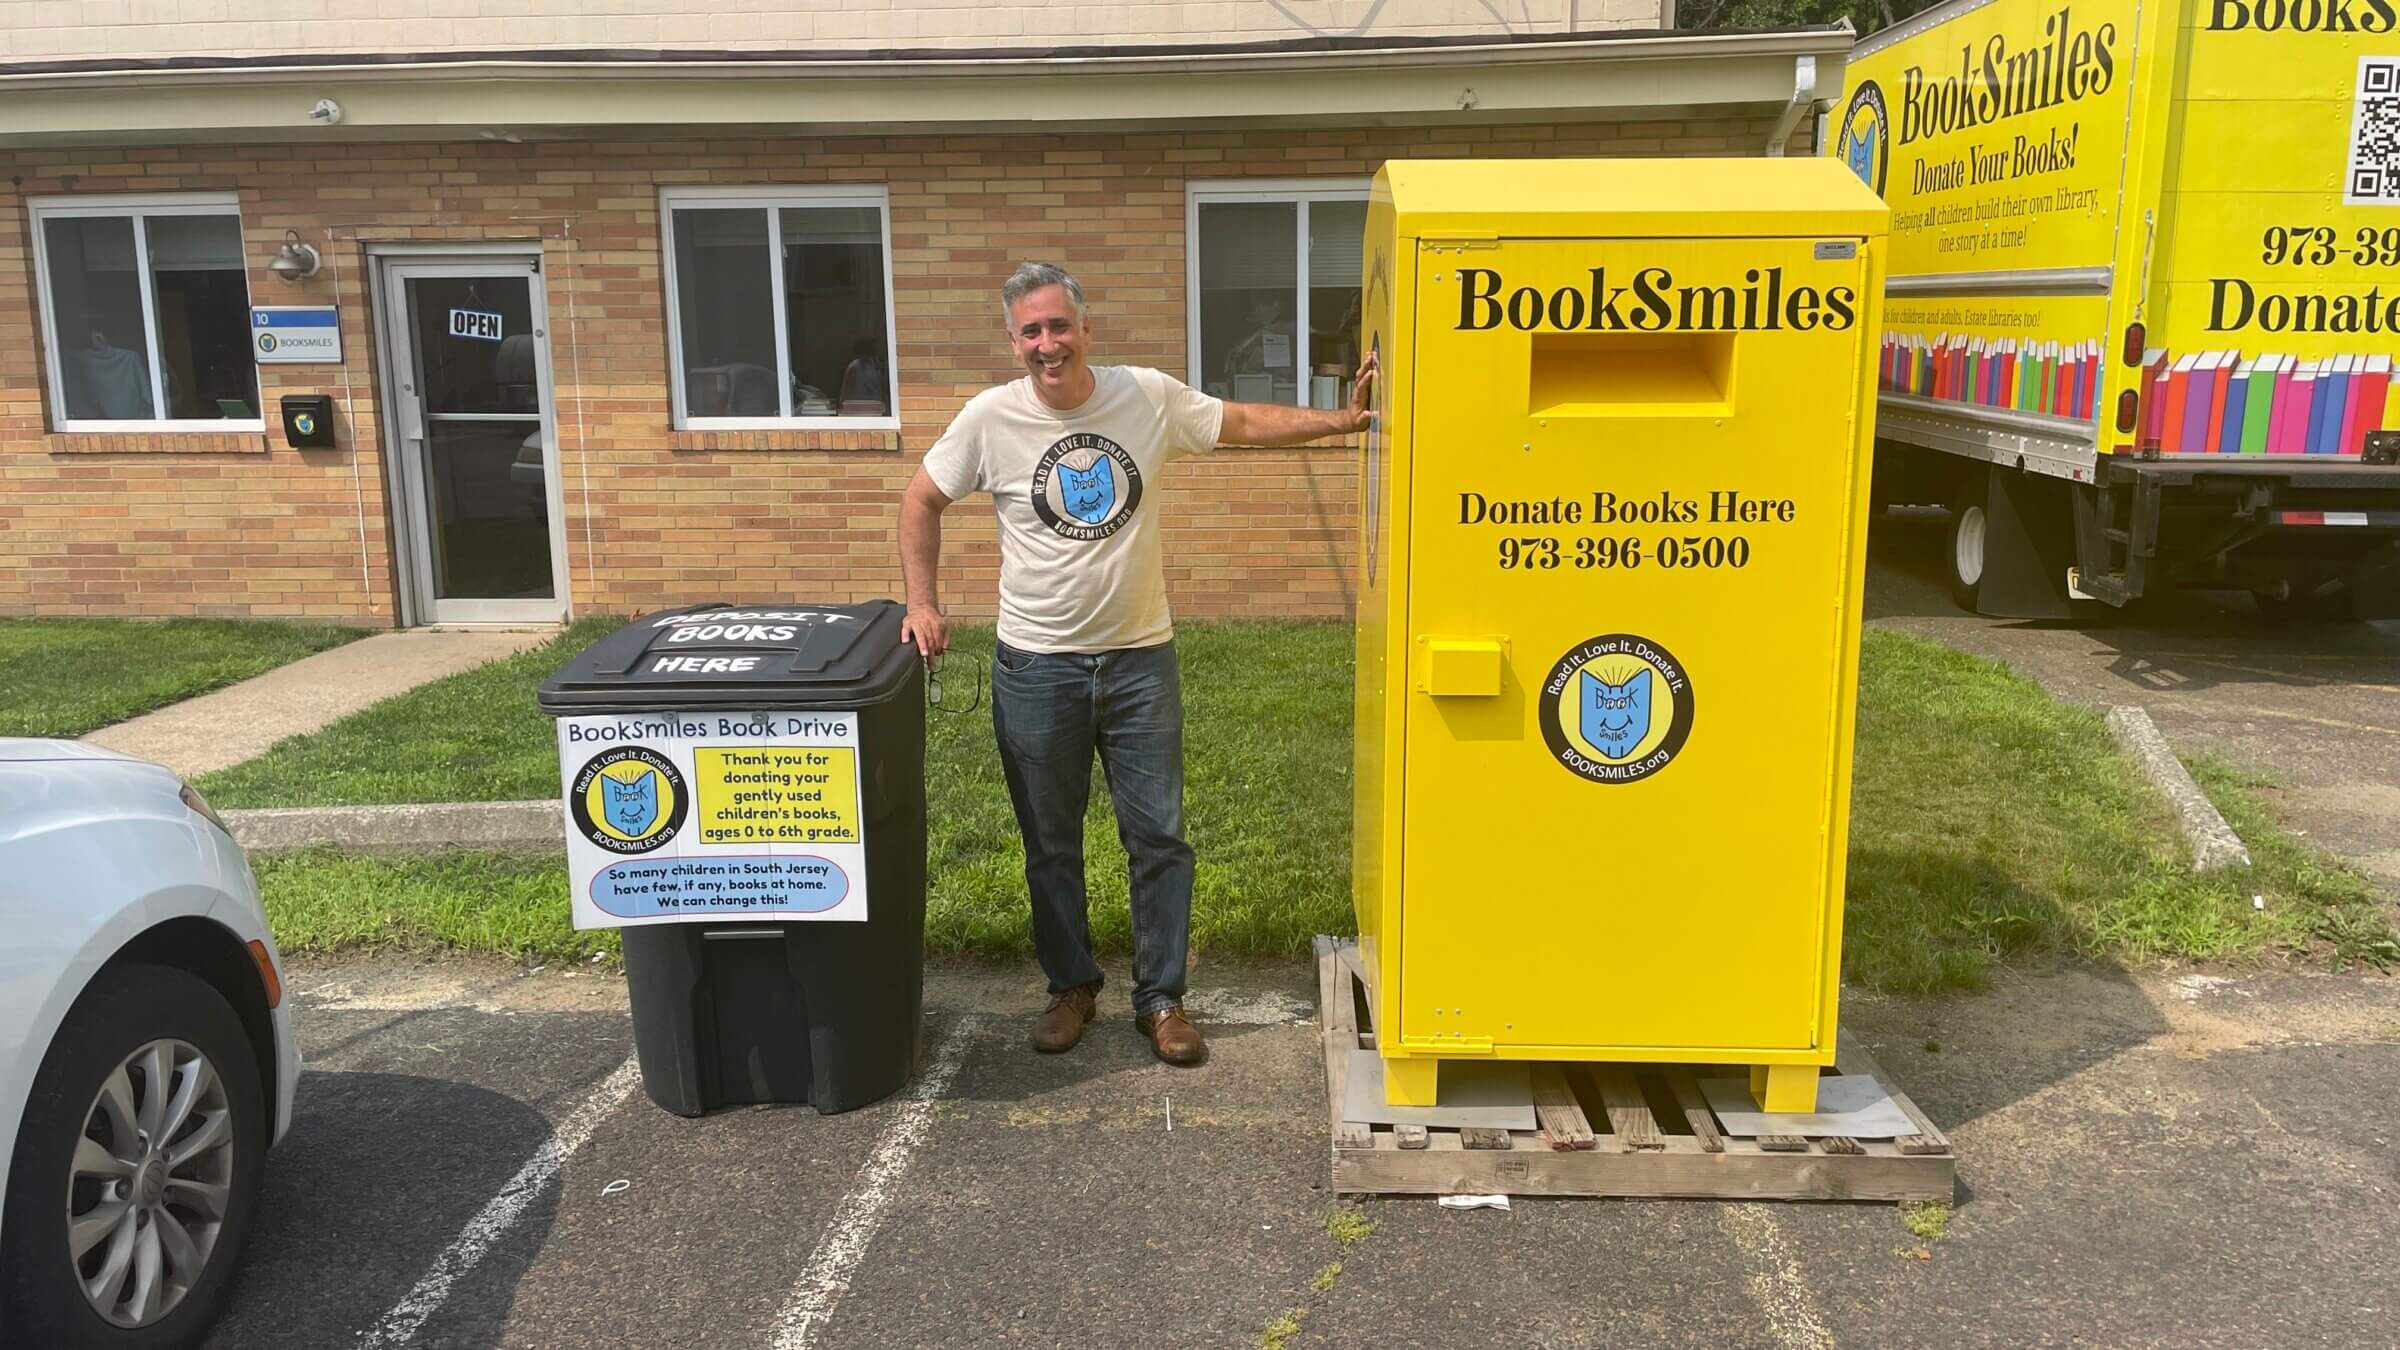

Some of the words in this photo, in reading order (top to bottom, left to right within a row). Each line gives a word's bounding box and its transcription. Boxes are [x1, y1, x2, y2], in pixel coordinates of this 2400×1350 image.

[1898, 6, 2116, 146] BookSmiles
[1912, 155, 1964, 196] Donate
[1970, 144, 2009, 186] Your
[2011, 122, 2079, 179] Books!
[1894, 211, 1923, 233] Helping
[1924, 207, 1935, 227] all
[1937, 204, 1973, 225] children
[1975, 197, 2000, 221] build
[2002, 194, 2027, 218] their
[2029, 195, 2053, 215] own
[2055, 187, 2099, 214] library,
[1938, 237, 1955, 253] one
[1956, 233, 1979, 256] story
[1980, 232, 1990, 249] at
[1992, 234, 1998, 249] a
[2000, 226, 2027, 248] time!
[2262, 226, 2400, 267] 973-39
[1454, 267, 1855, 331] BookSmiles
[255, 313, 269, 326] 10
[454, 311, 498, 338] OPEN
[1900, 308, 1926, 325] children
[1927, 308, 1939, 325] and
[1964, 309, 1987, 326] Estate
[1989, 308, 2022, 328] libraries
[2024, 310, 2041, 328] too!
[281, 339, 333, 348] BOOKSMILES
[1034, 468, 1049, 495] READ
[1054, 437, 1080, 456] LOVE
[1082, 435, 1094, 447] IT.
[1097, 439, 1131, 472] DONATE
[1458, 492, 1582, 525] Donate
[1592, 491, 1698, 524] Books
[1706, 490, 1795, 523] Here
[1054, 507, 1132, 539] BOOKSMILES.ORG
[1499, 536, 1750, 570] 973-396-0500
[652, 612, 855, 628] DEPOSIT
[668, 624, 799, 643] BOOKS
[652, 656, 761, 673] HERE
[1547, 662, 1572, 695] Read
[1570, 653, 1585, 664] It.
[1584, 642, 1617, 659] Love
[1620, 639, 1633, 653] It.
[1635, 643, 1676, 679] Donate
[1671, 679, 1684, 694] It.
[569, 719, 708, 743] BookSmiles
[718, 718, 777, 738] Book
[788, 718, 848, 737] Drive
[576, 771, 594, 793] Read
[591, 762, 603, 772] It.
[601, 752, 626, 765] Love
[628, 749, 639, 760] It.
[640, 751, 673, 777] Donate
[721, 753, 770, 766] Thank
[775, 756, 802, 768] you
[806, 753, 829, 766] for
[1562, 749, 1670, 779] BOOKSMILES.org
[724, 771, 790, 786] donating
[795, 773, 829, 786] your
[734, 789, 783, 804] gently
[787, 789, 822, 801] used
[717, 808, 790, 820] children's
[794, 807, 841, 821] books,
[593, 826, 675, 851] BOOKSMILES.org
[705, 828, 740, 840] ages
[744, 826, 754, 837] 0
[758, 826, 774, 837] to
[779, 825, 803, 837] 6th
[807, 825, 854, 840] grade.
[609, 869, 626, 880] So
[631, 868, 667, 881] many
[672, 864, 724, 876] children
[729, 864, 740, 875] in
[744, 863, 782, 874] South
[786, 863, 829, 876] Jersey
[614, 884, 648, 896] have
[653, 882, 682, 894] few,
[684, 880, 694, 891] if
[698, 882, 726, 893] any,
[730, 879, 767, 890] books
[771, 880, 785, 890] at
[788, 879, 827, 890] home.
[657, 896, 680, 908] We
[683, 896, 706, 907] can
[710, 895, 757, 908] change
[761, 894, 789, 906] this!
